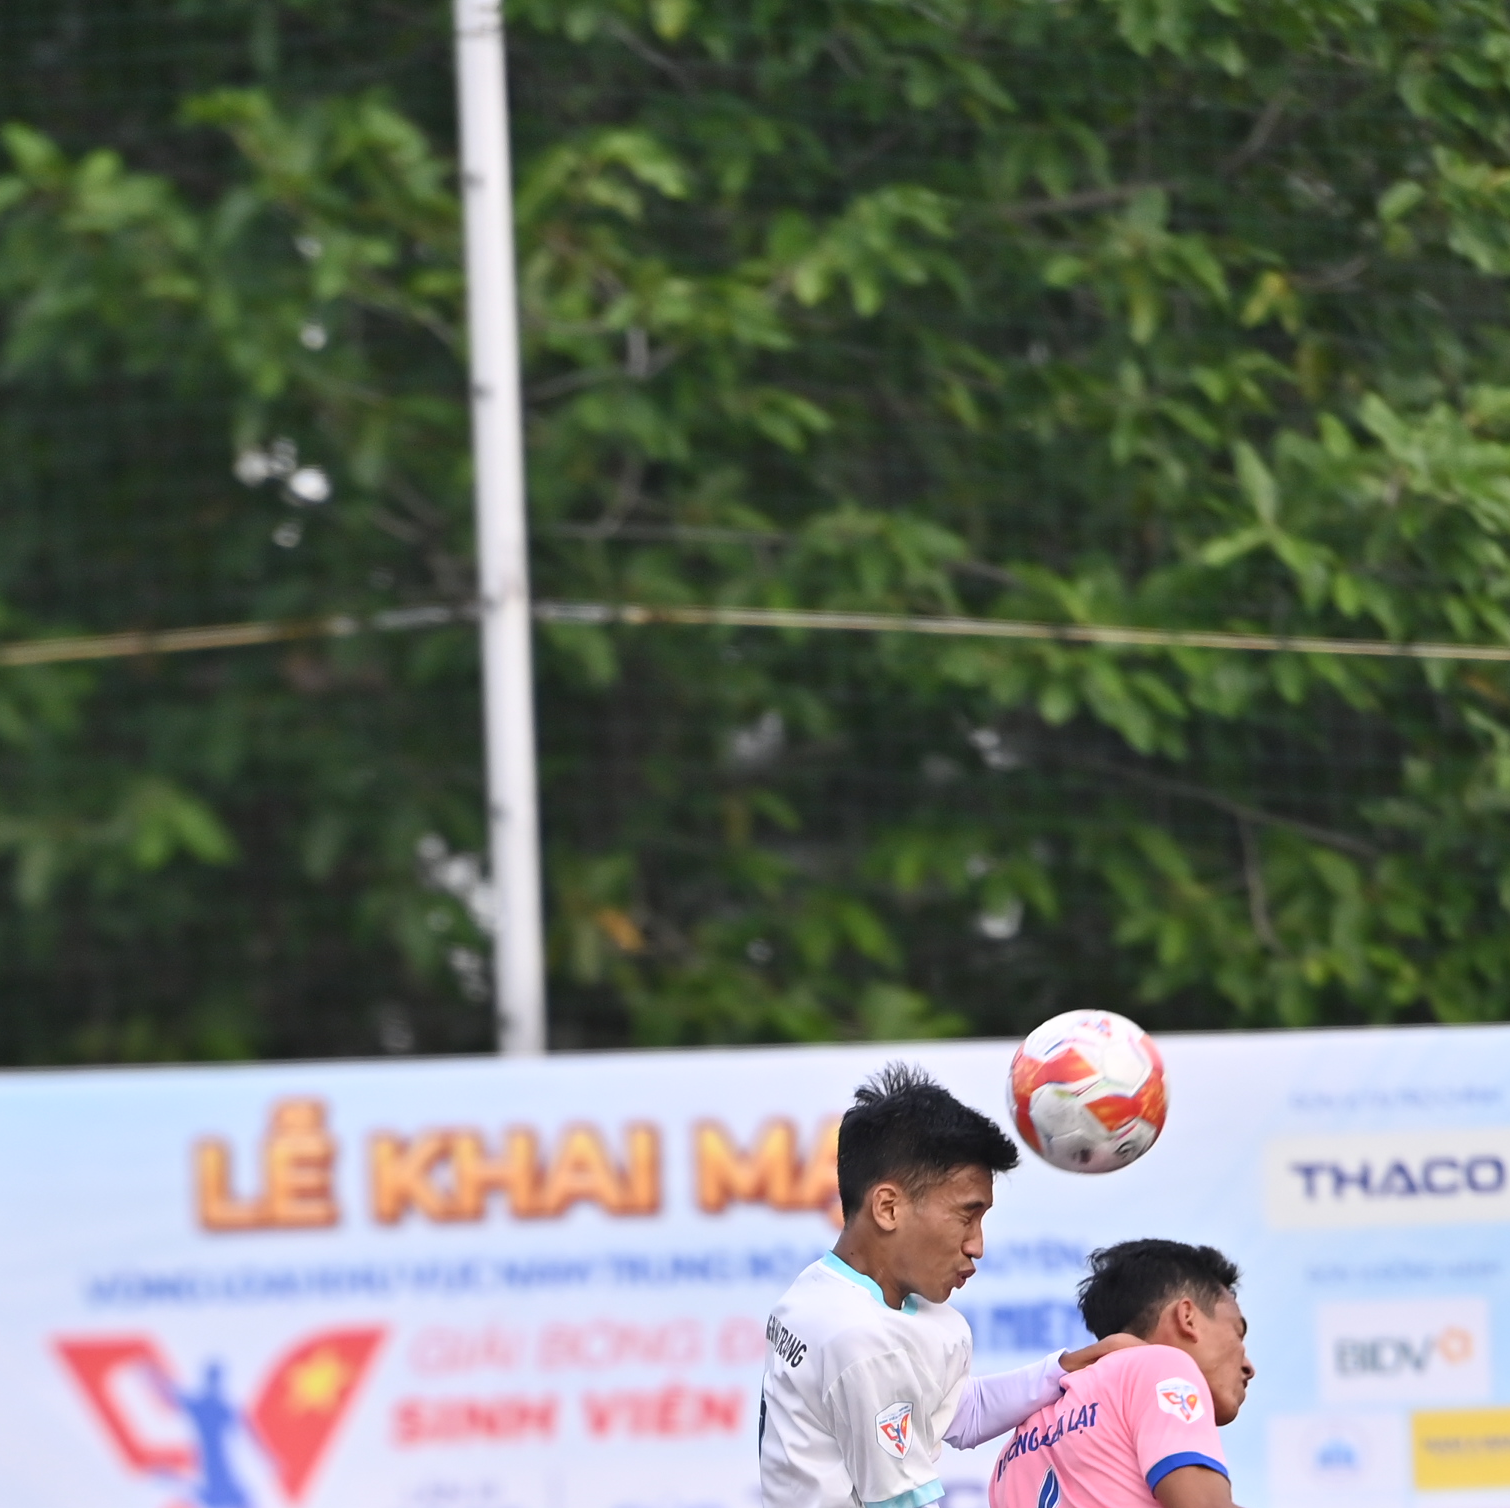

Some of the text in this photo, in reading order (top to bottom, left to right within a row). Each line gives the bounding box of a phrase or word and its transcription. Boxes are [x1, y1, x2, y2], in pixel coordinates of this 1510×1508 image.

[193, 1096, 339, 1232] LỄ
[367, 1120, 663, 1224] KHAI
[1289, 1154, 1507, 1202] THACO
[391, 1388, 559, 1450] SINH
[579, 1372, 747, 1441] VIÊN
